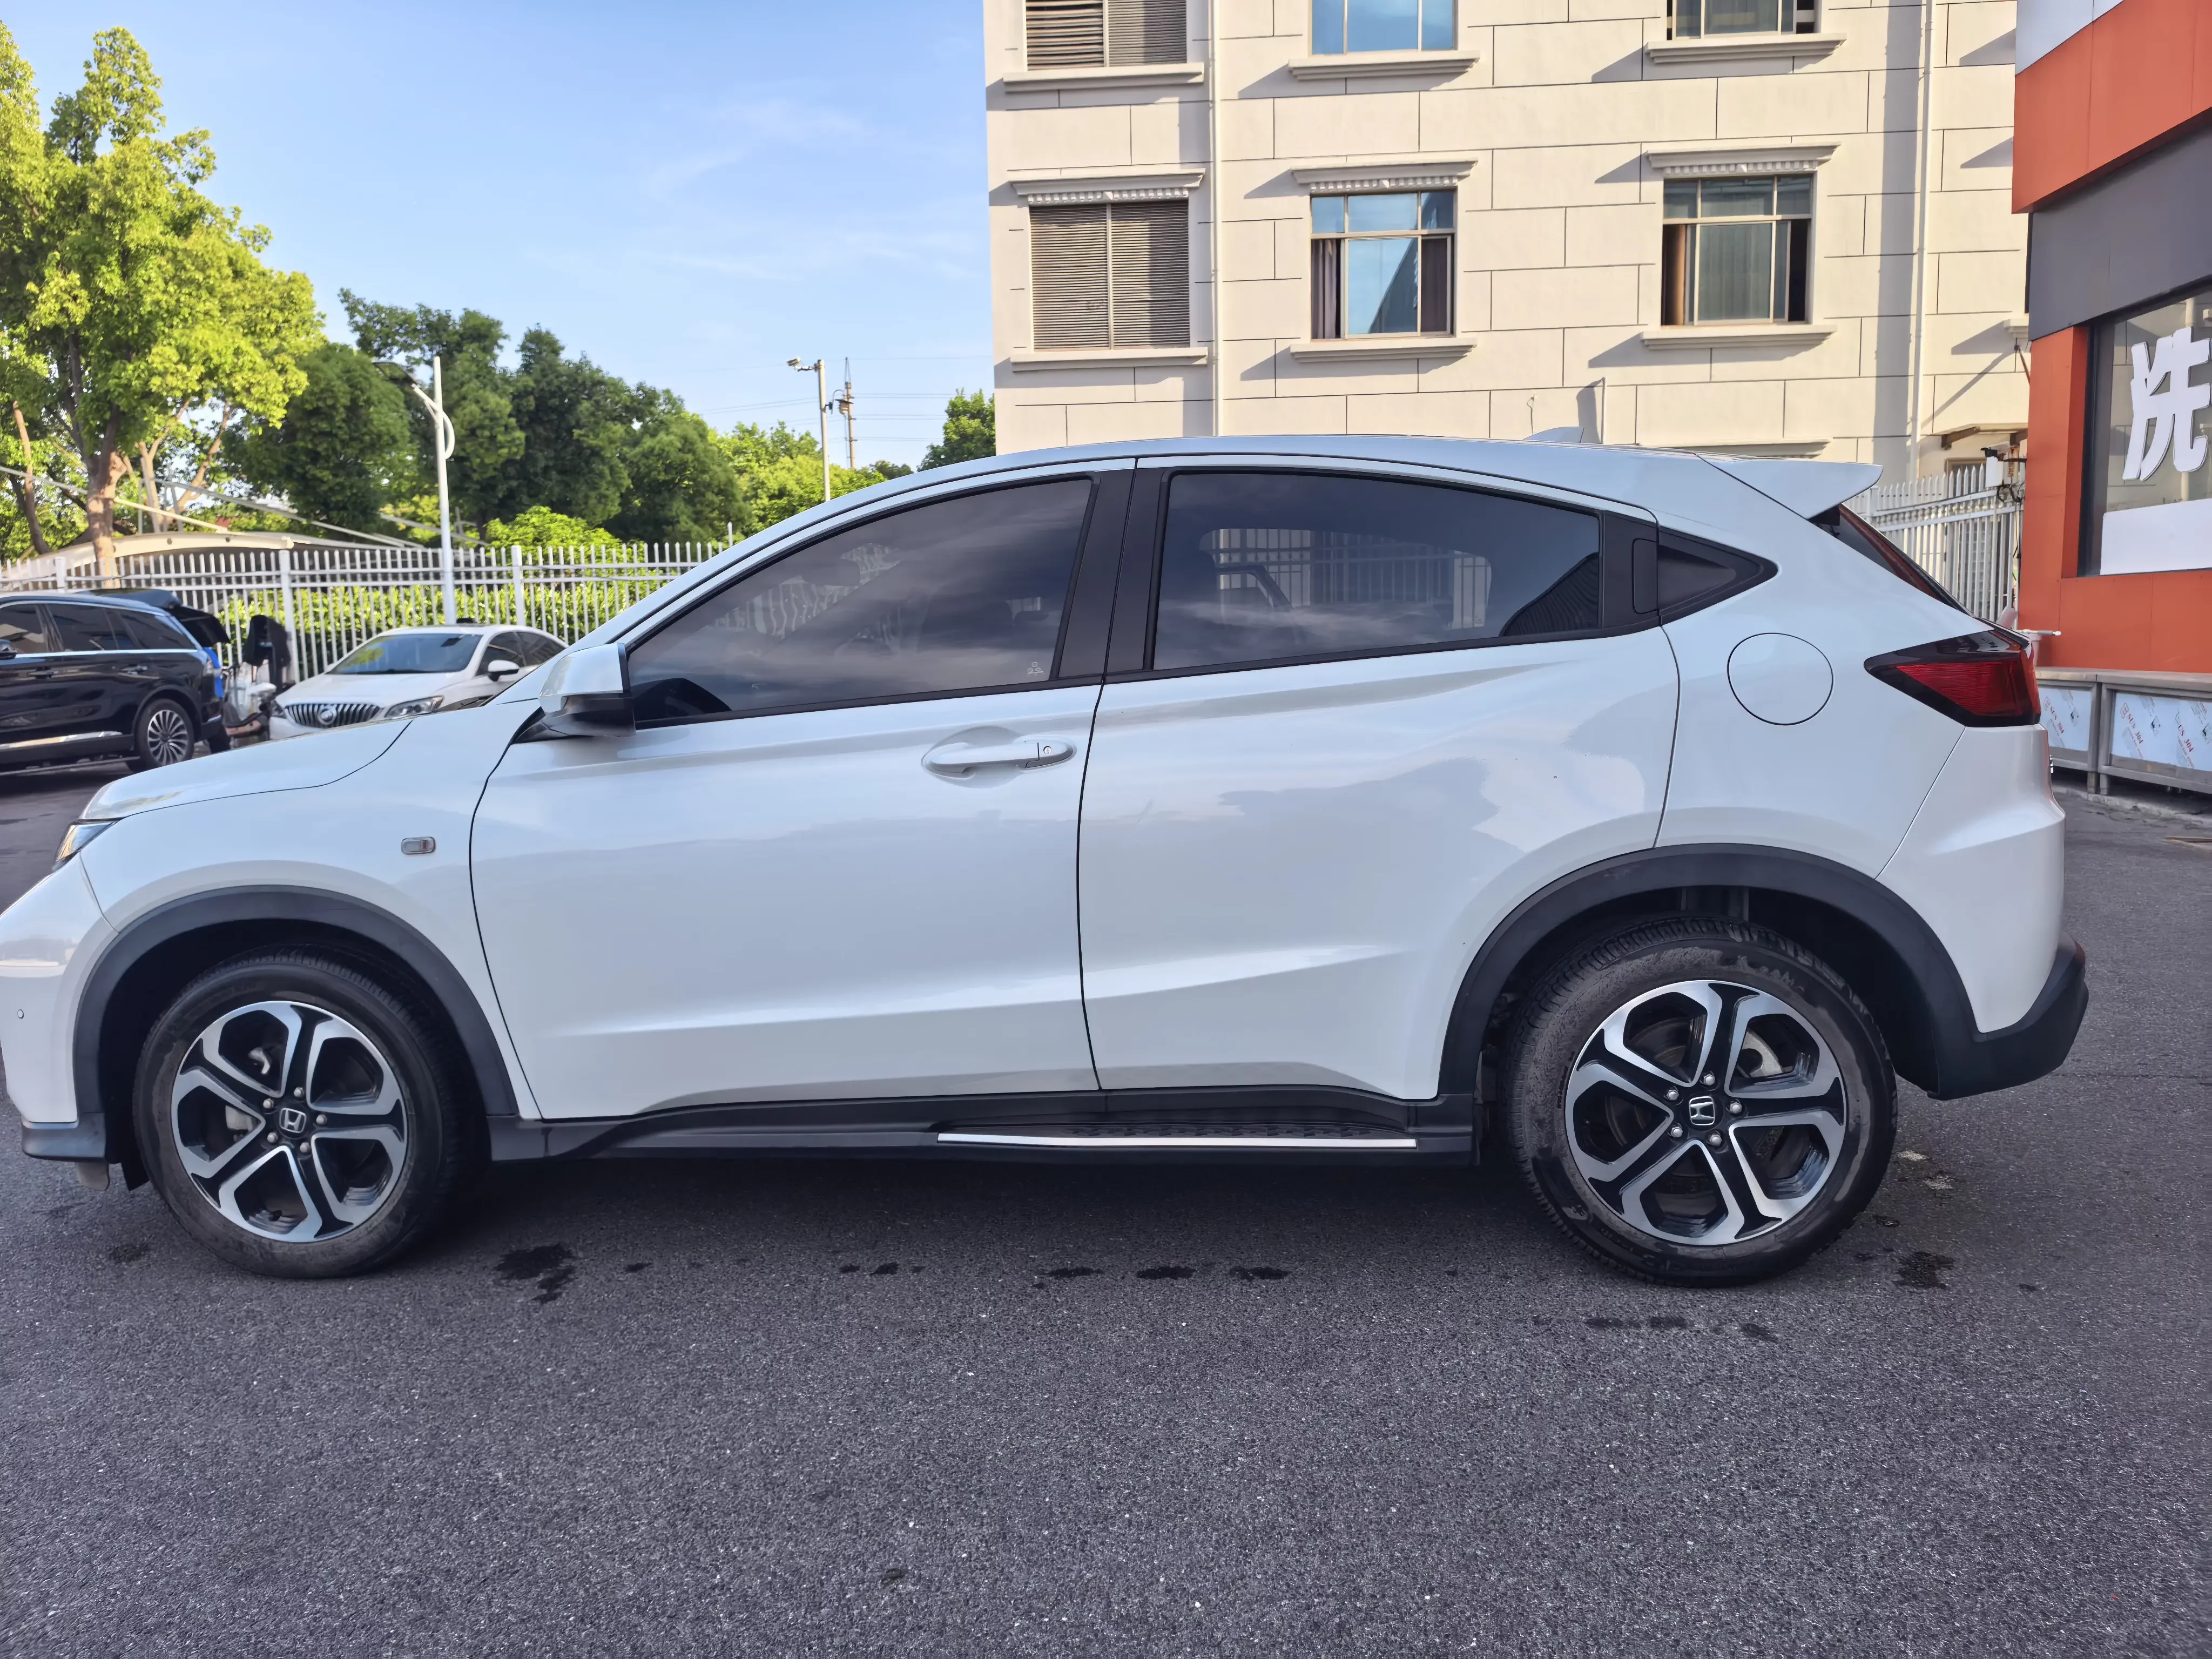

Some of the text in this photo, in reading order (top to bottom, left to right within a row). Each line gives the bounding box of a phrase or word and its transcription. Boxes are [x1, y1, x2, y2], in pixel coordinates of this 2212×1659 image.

[2122, 326, 2211, 482] 洗
[2127, 713, 2136, 729] SUS
[2135, 731, 2143, 744] 304
[2183, 738, 2194, 752] 304
